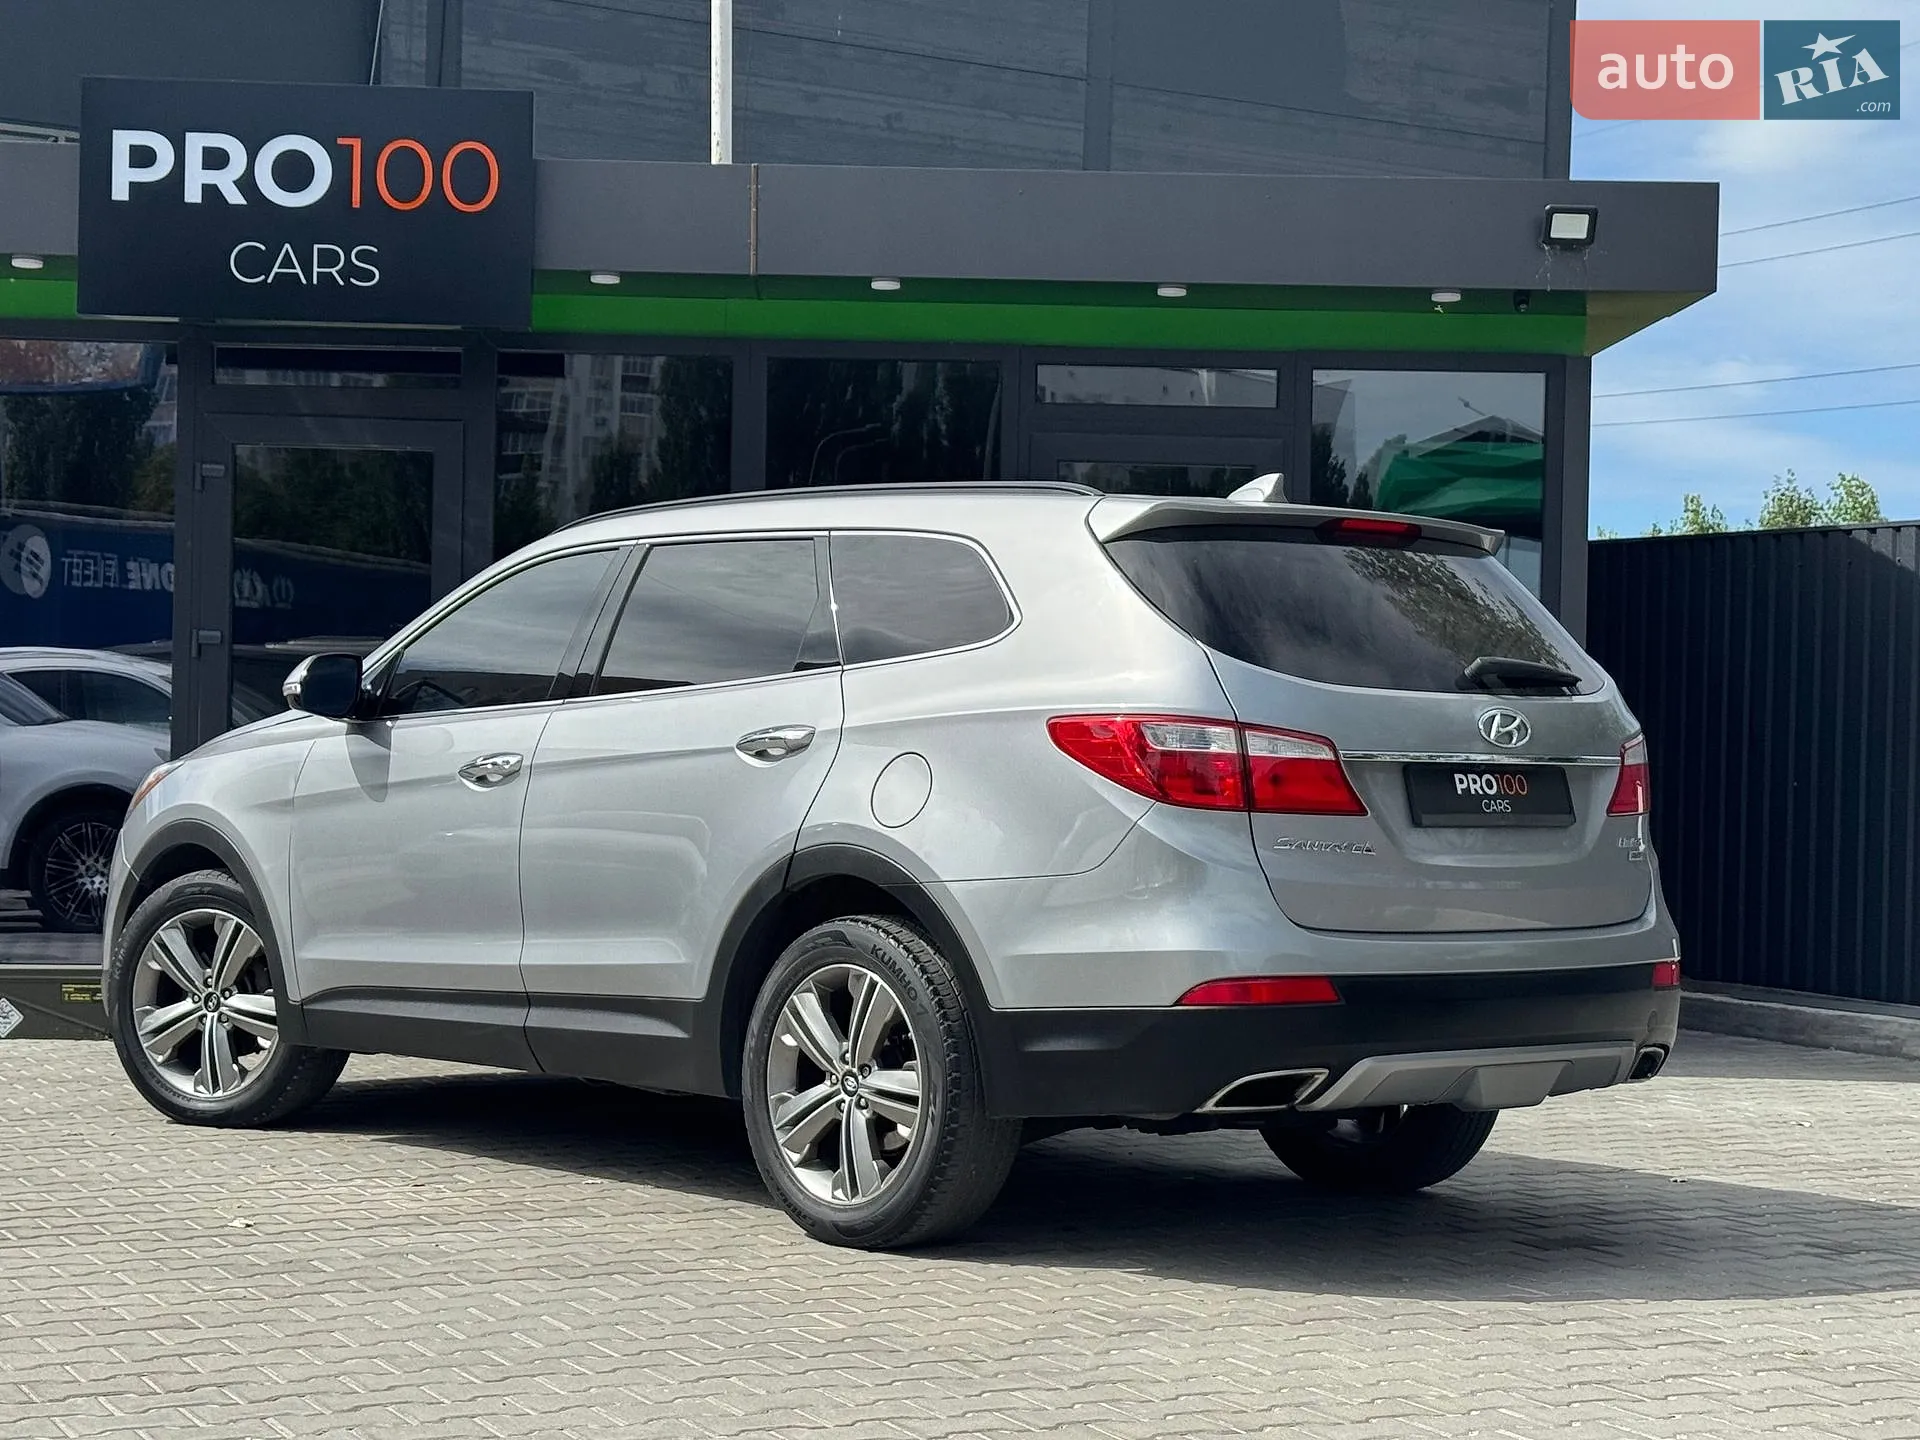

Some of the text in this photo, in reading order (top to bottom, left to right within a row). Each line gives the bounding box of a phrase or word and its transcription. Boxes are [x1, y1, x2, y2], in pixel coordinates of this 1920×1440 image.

[111, 129, 499, 213] PRO100
[229, 241, 380, 287] CARS
[1454, 773, 1529, 796] PRO100
[1482, 799, 1512, 813] CARS
[870, 943, 918, 1002] KUMHO
